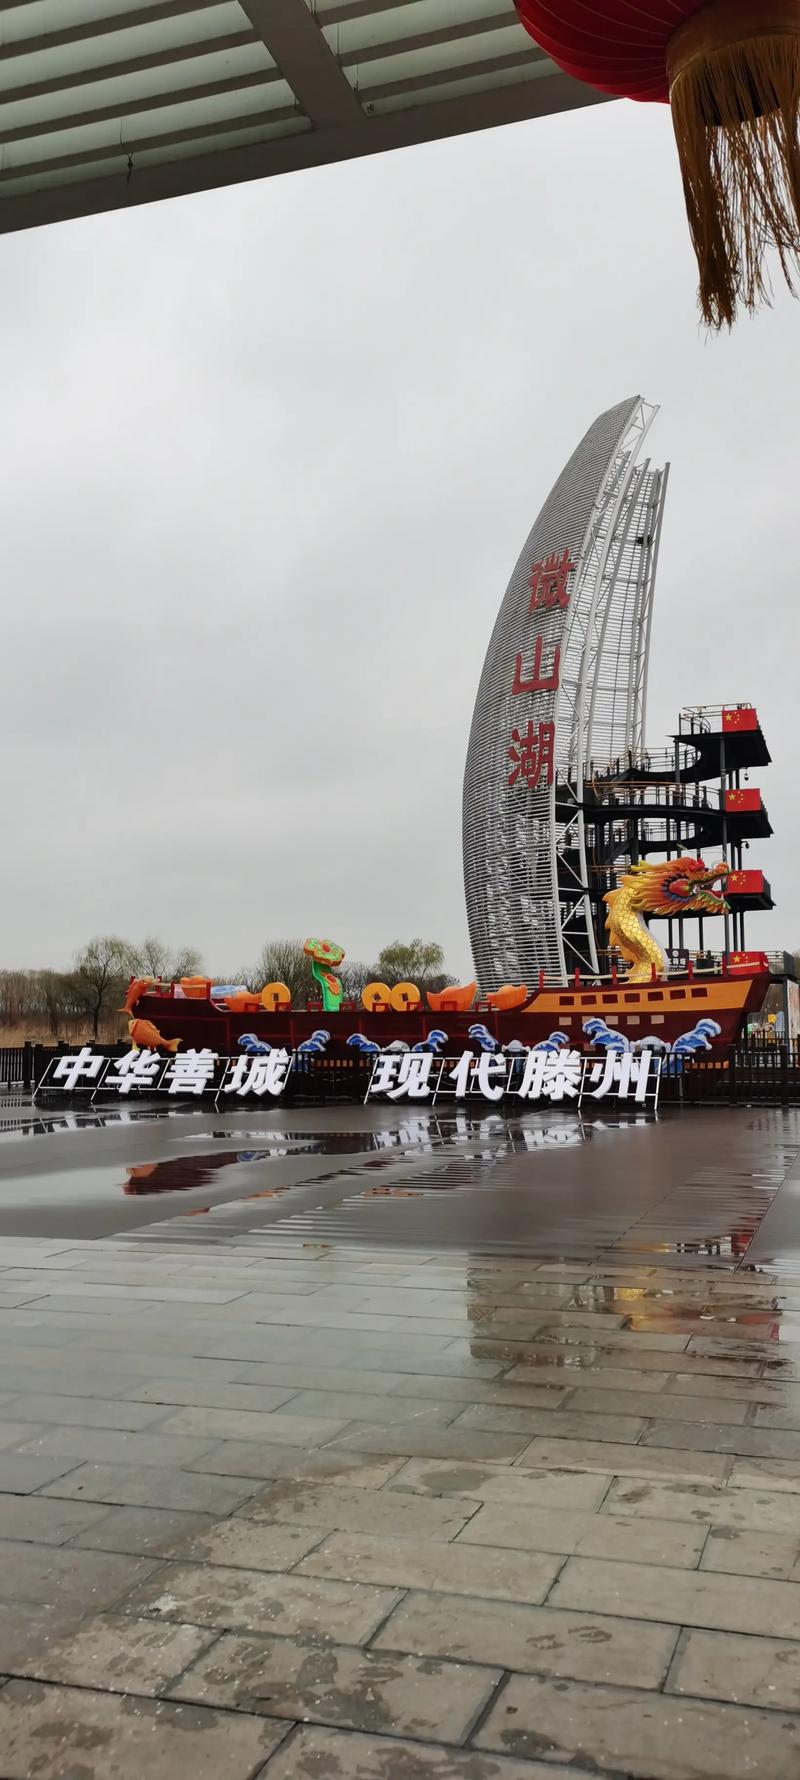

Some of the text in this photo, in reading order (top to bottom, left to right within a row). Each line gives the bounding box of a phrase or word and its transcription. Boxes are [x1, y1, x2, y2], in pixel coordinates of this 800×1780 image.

[507, 548, 576, 789] 微山湖
[52, 1047, 652, 1102] 中华善城 现代滕州
